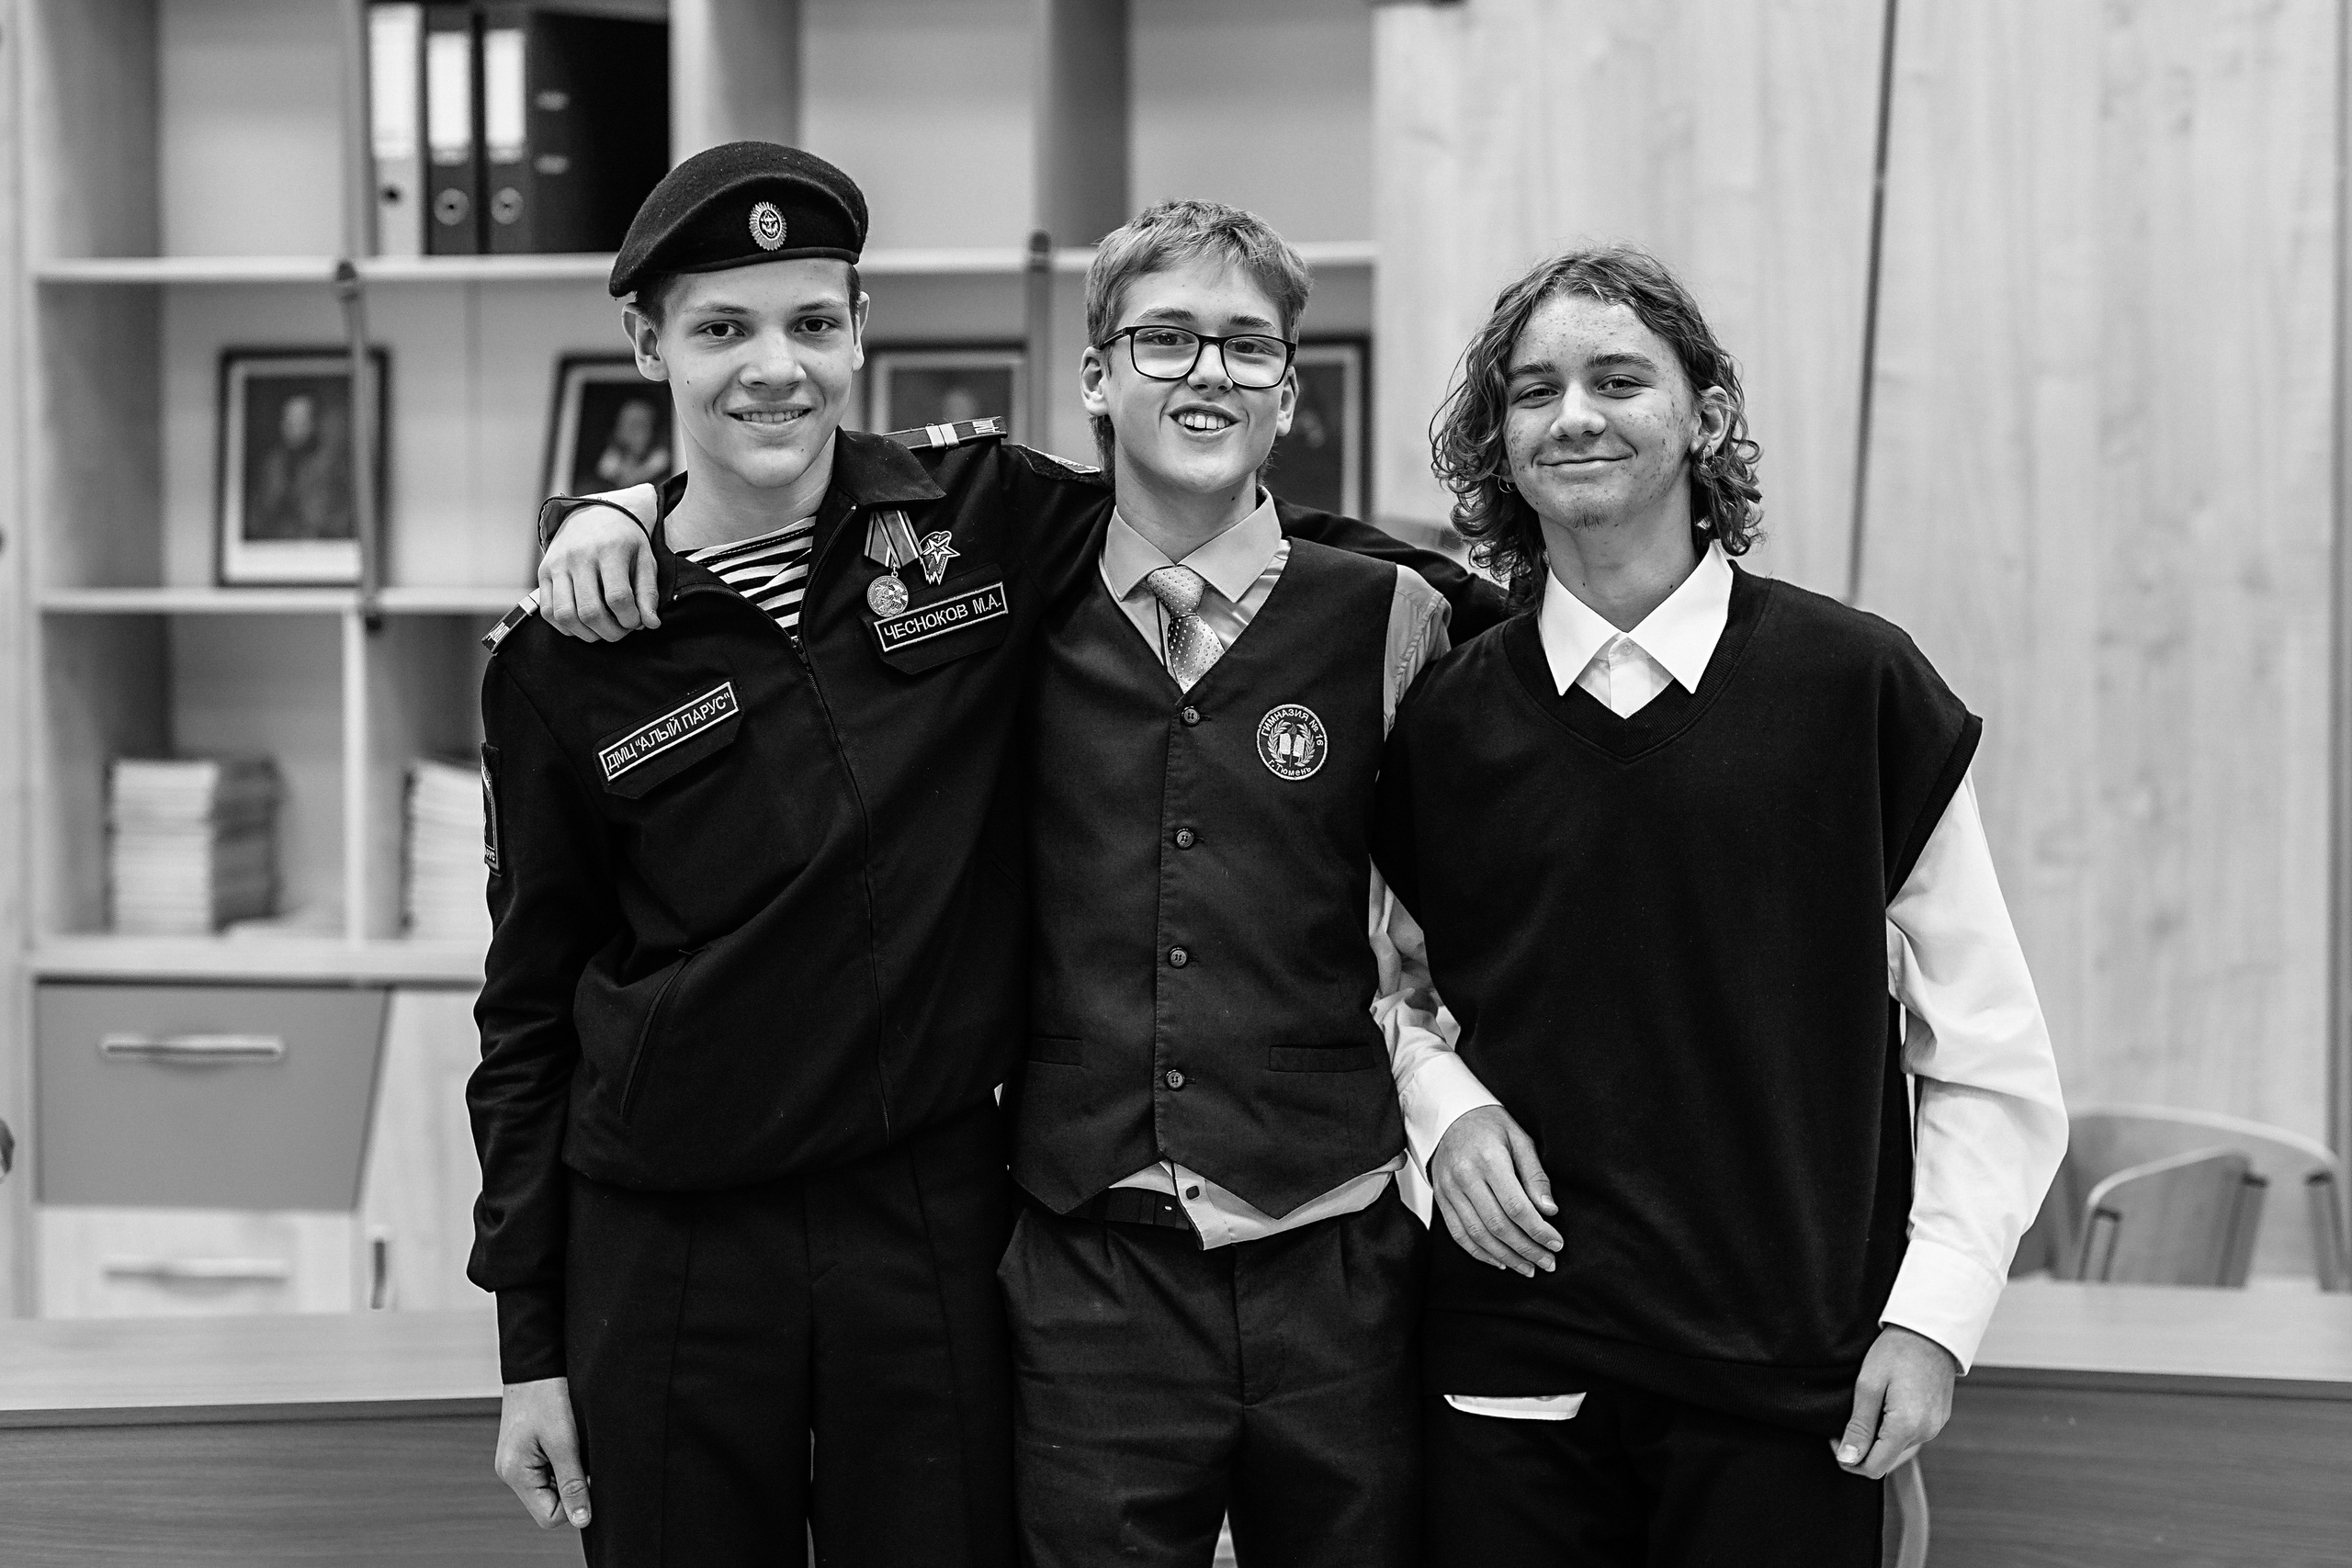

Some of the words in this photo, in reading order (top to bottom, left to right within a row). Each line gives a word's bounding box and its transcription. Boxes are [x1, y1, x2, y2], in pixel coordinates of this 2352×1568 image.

[884, 604, 968, 639] ЧЕСНОКОВ
[972, 593, 1002, 615] М.А.
[1261, 708, 1309, 737] ГИМНАЗИЯ
[1315, 734, 1324, 746] 16
[606, 742, 639, 773] ДМЦ
